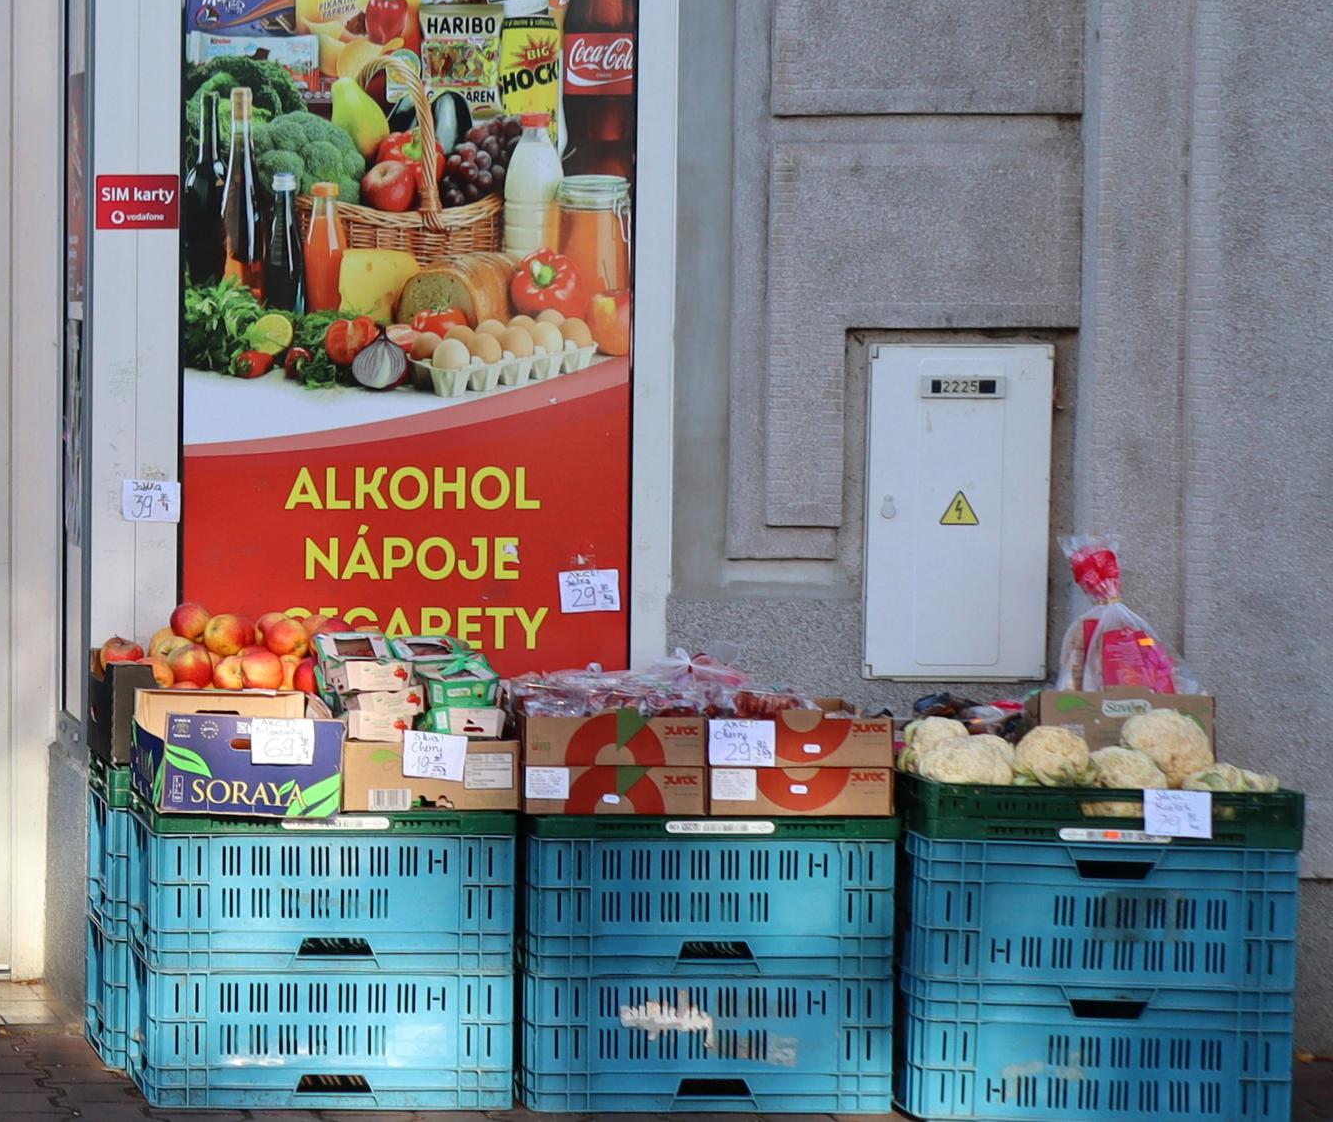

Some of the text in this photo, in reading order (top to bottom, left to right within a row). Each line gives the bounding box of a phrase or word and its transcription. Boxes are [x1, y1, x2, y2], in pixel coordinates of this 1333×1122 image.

[426, 16, 495, 35] HARIBO
[526, 47, 550, 61] BIG
[101, 187, 174, 205] SIM karty
[126, 212, 165, 221] vodafone
[942, 380, 978, 393] 2225
[284, 466, 542, 511] ALKOHOL
[131, 494, 153, 518] 39
[304, 524, 521, 581] NÁPOJE
[572, 586, 597, 607] 29
[282, 606, 549, 650] ARETY
[724, 742, 751, 761] 29
[190, 778, 308, 811] SORAYA
